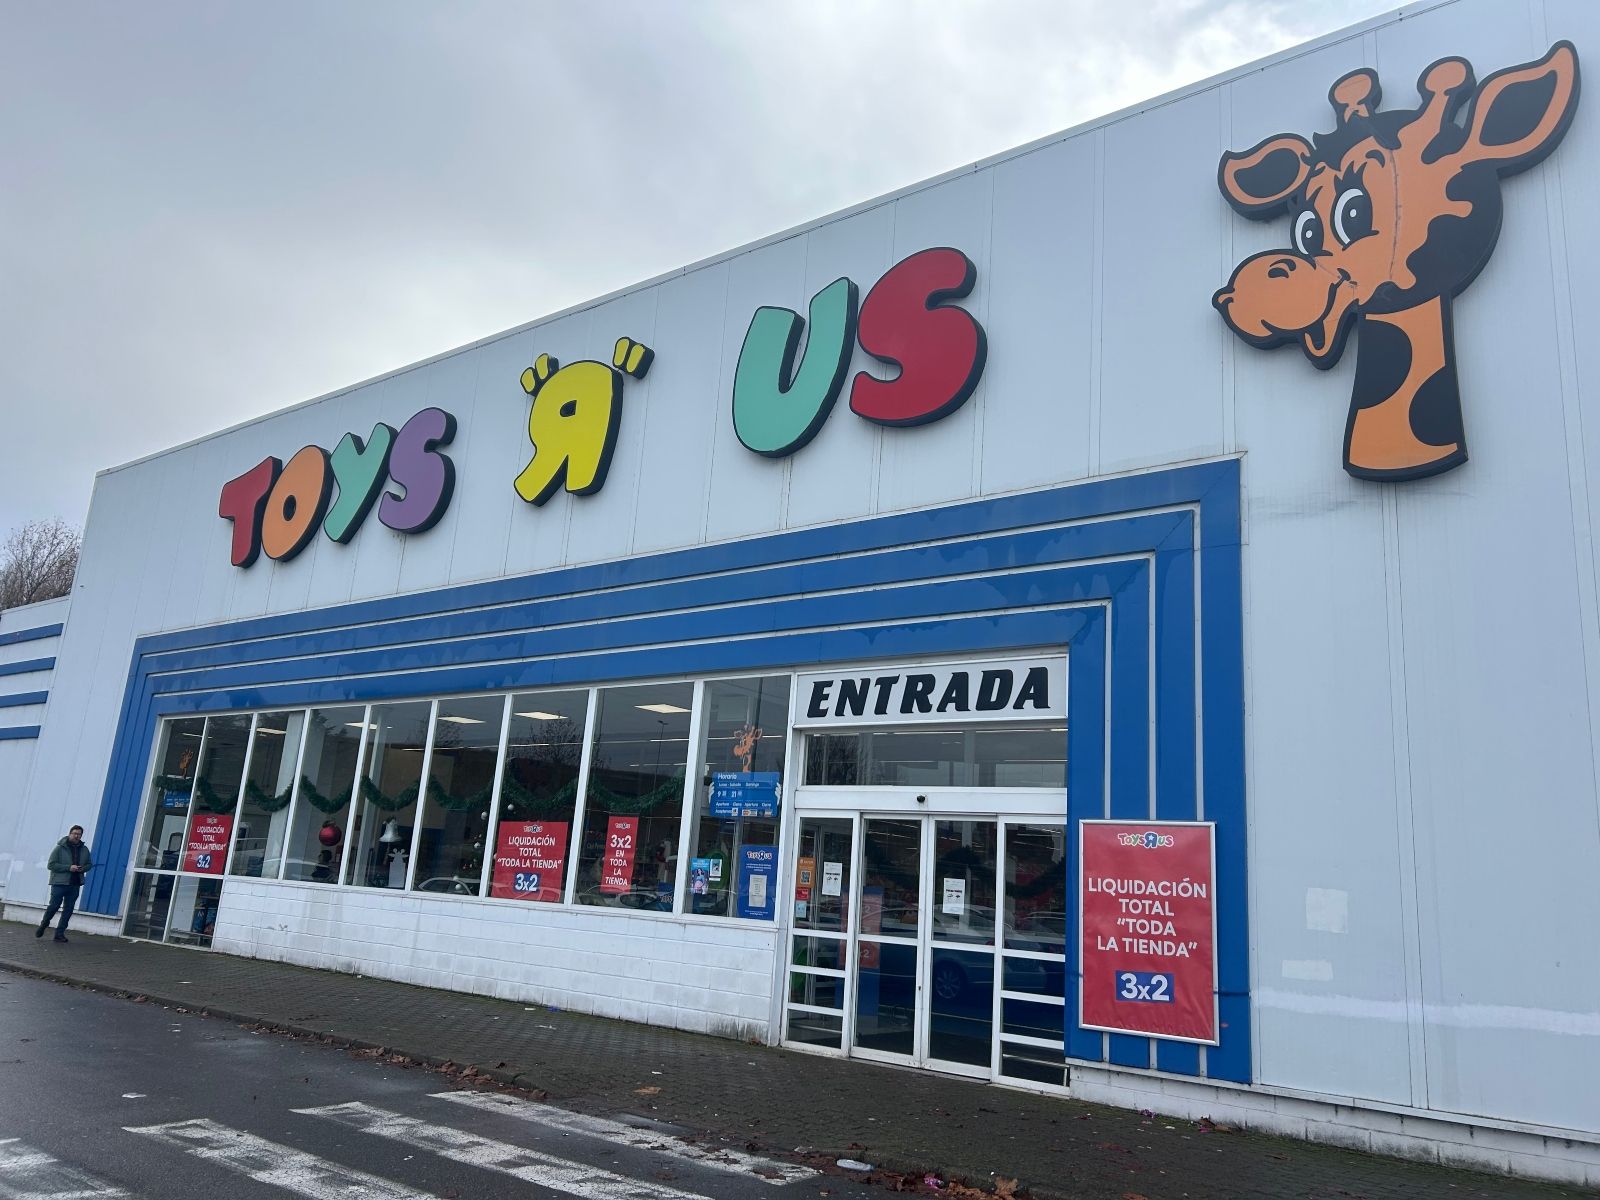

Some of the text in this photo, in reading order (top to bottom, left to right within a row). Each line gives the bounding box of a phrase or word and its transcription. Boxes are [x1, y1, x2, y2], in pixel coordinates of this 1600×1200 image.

[219, 407, 457, 568] TOYS
[732, 246, 988, 458] US
[807, 667, 1051, 718] ENTRADA
[717, 772, 738, 780] Horario
[203, 834, 215, 842] TOTAL
[508, 834, 556, 847] LIQUIDACIÓN
[610, 834, 632, 849] 3x2
[519, 847, 541, 857] TOTAL
[197, 854, 211, 869] 3x2
[521, 858, 531, 868] LA
[609, 858, 627, 867] TODA
[613, 868, 622, 876] LA
[514, 873, 538, 892] 3x2
[605, 877, 628, 886] TIENDA
[1088, 877, 1207, 898] LIQUIDACIÓN
[1119, 898, 1175, 917] TOTAL
[1097, 936, 1198, 958] LA TIENDA"
[1120, 972, 1170, 1001] 3x2
